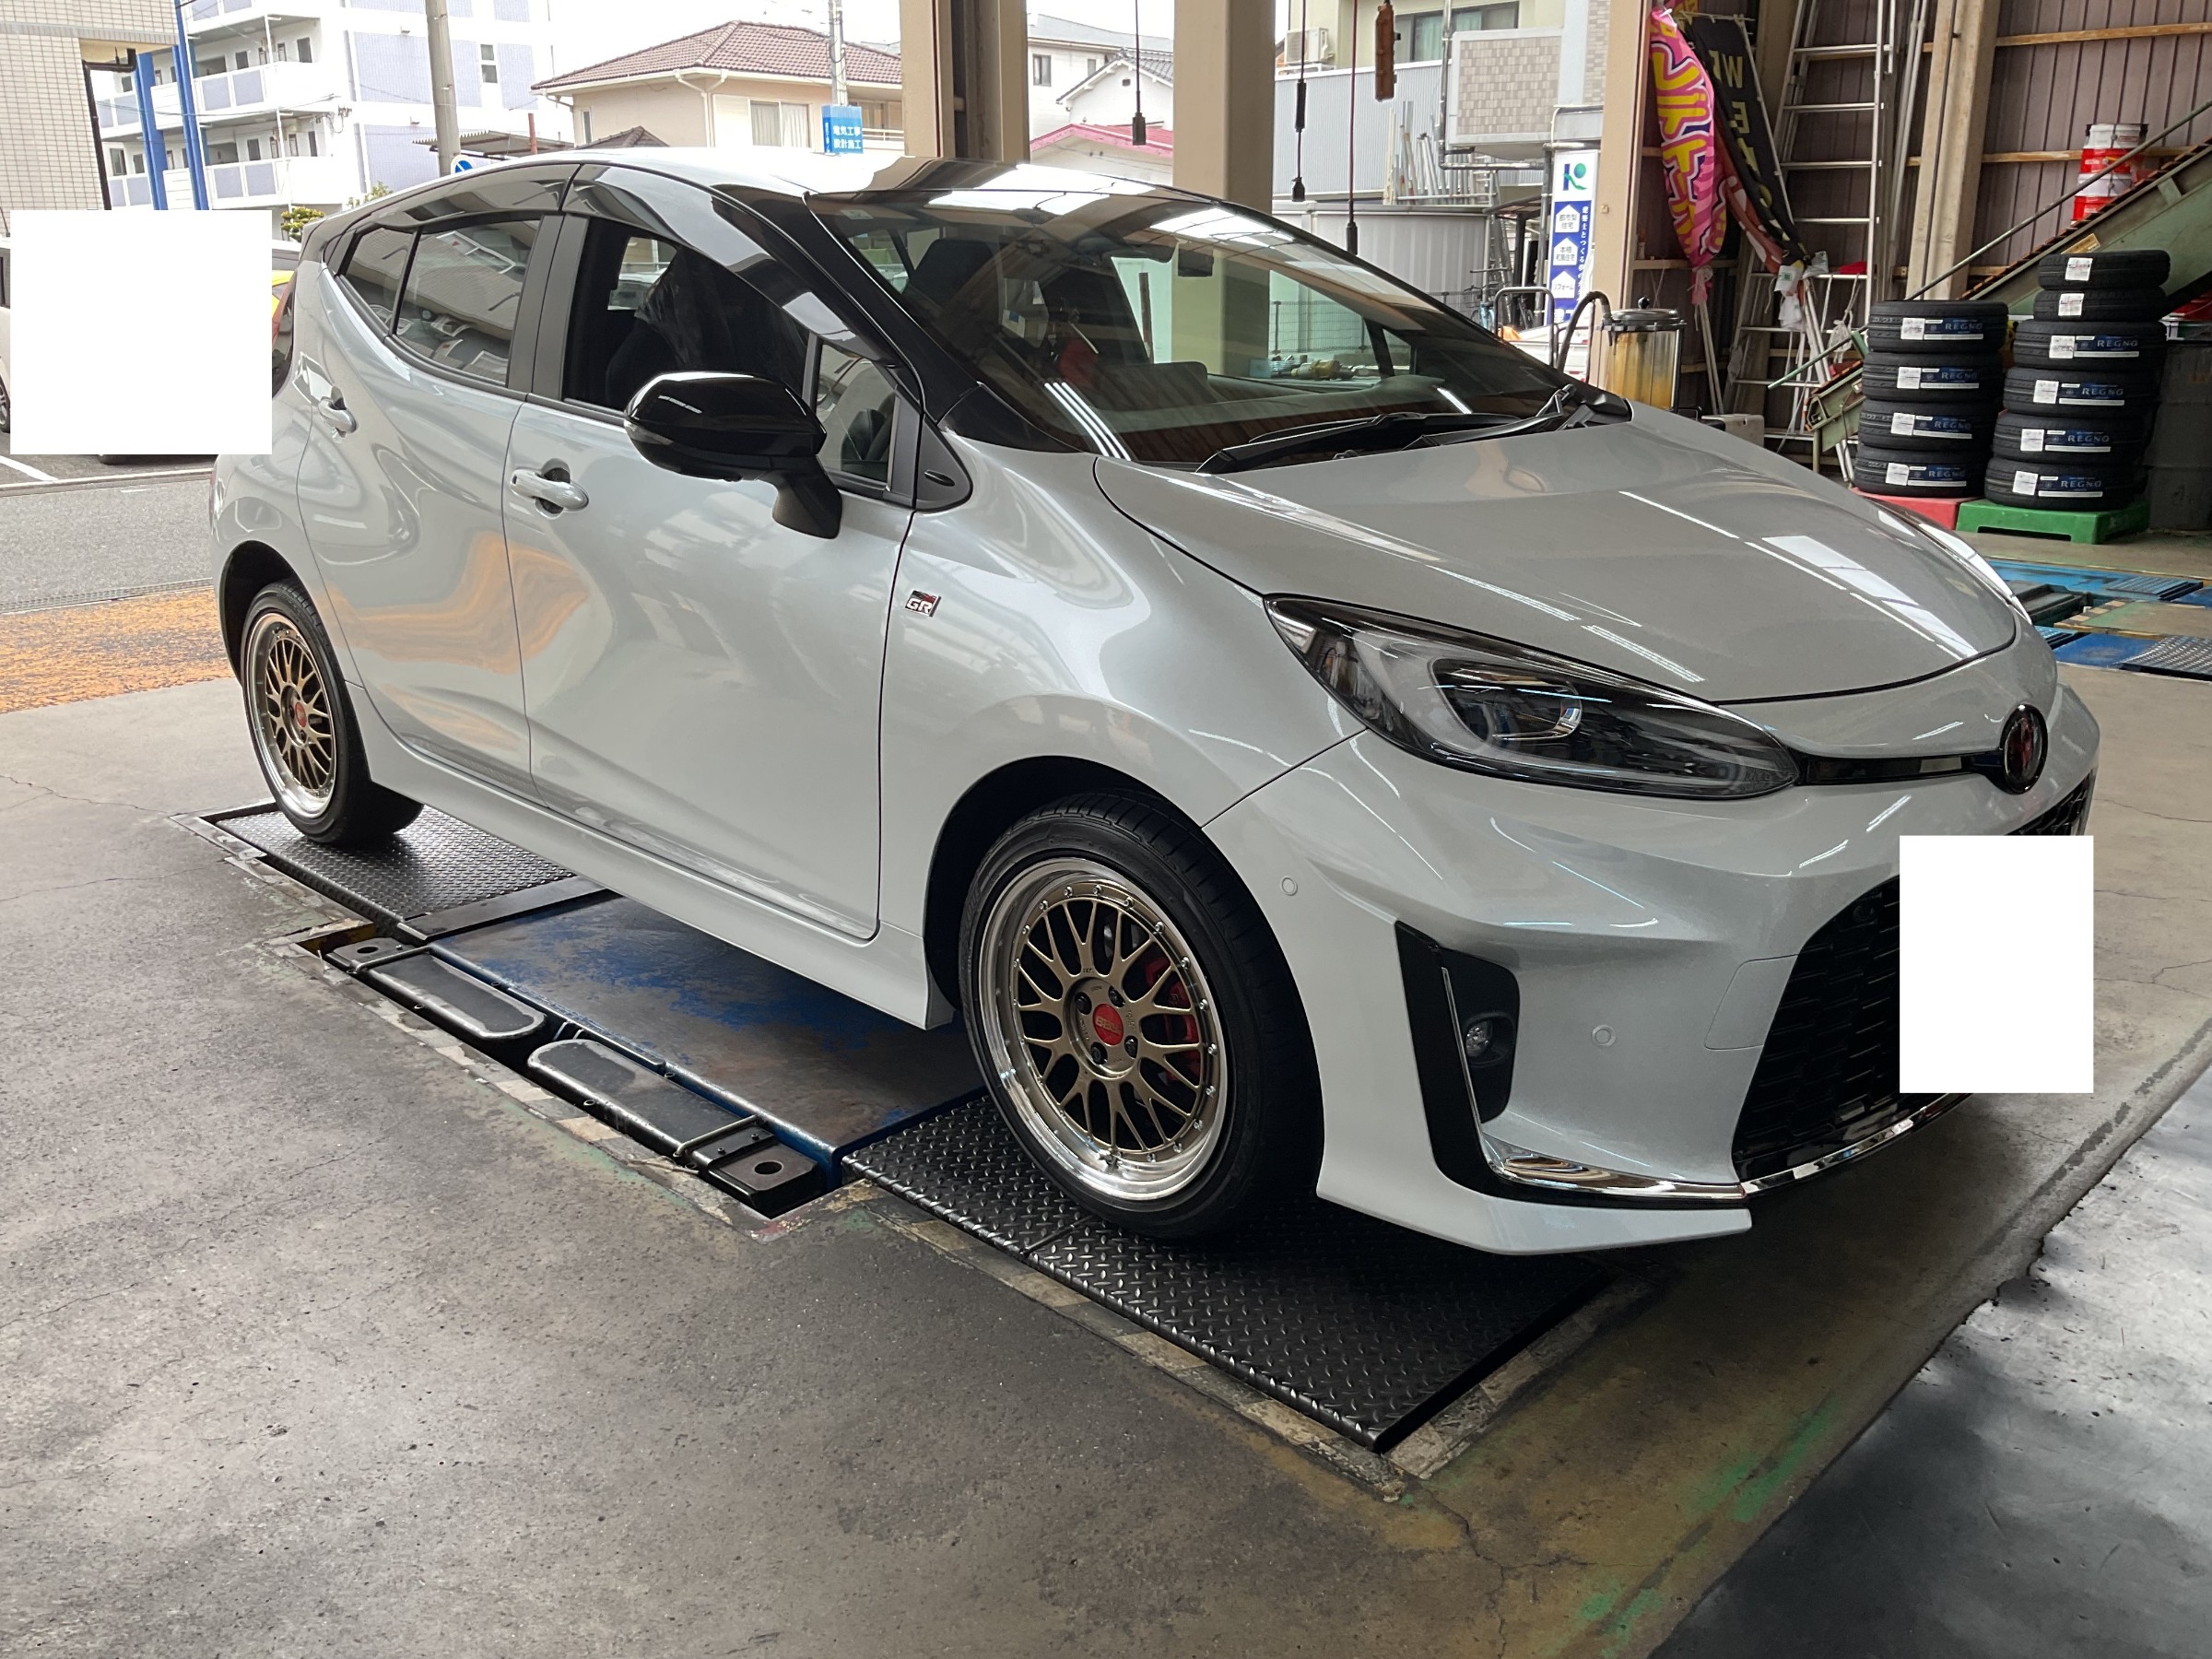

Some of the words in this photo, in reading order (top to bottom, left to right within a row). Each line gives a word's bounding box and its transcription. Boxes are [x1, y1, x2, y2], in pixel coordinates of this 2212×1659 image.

[1945, 323, 1983, 331] REGNO
[2097, 339, 2139, 347] REGNO
[2082, 387, 2124, 395] REGNO
[2067, 434, 2111, 442] REGNO
[2061, 479, 2102, 488] REGNO
[907, 597, 932, 613] GR
